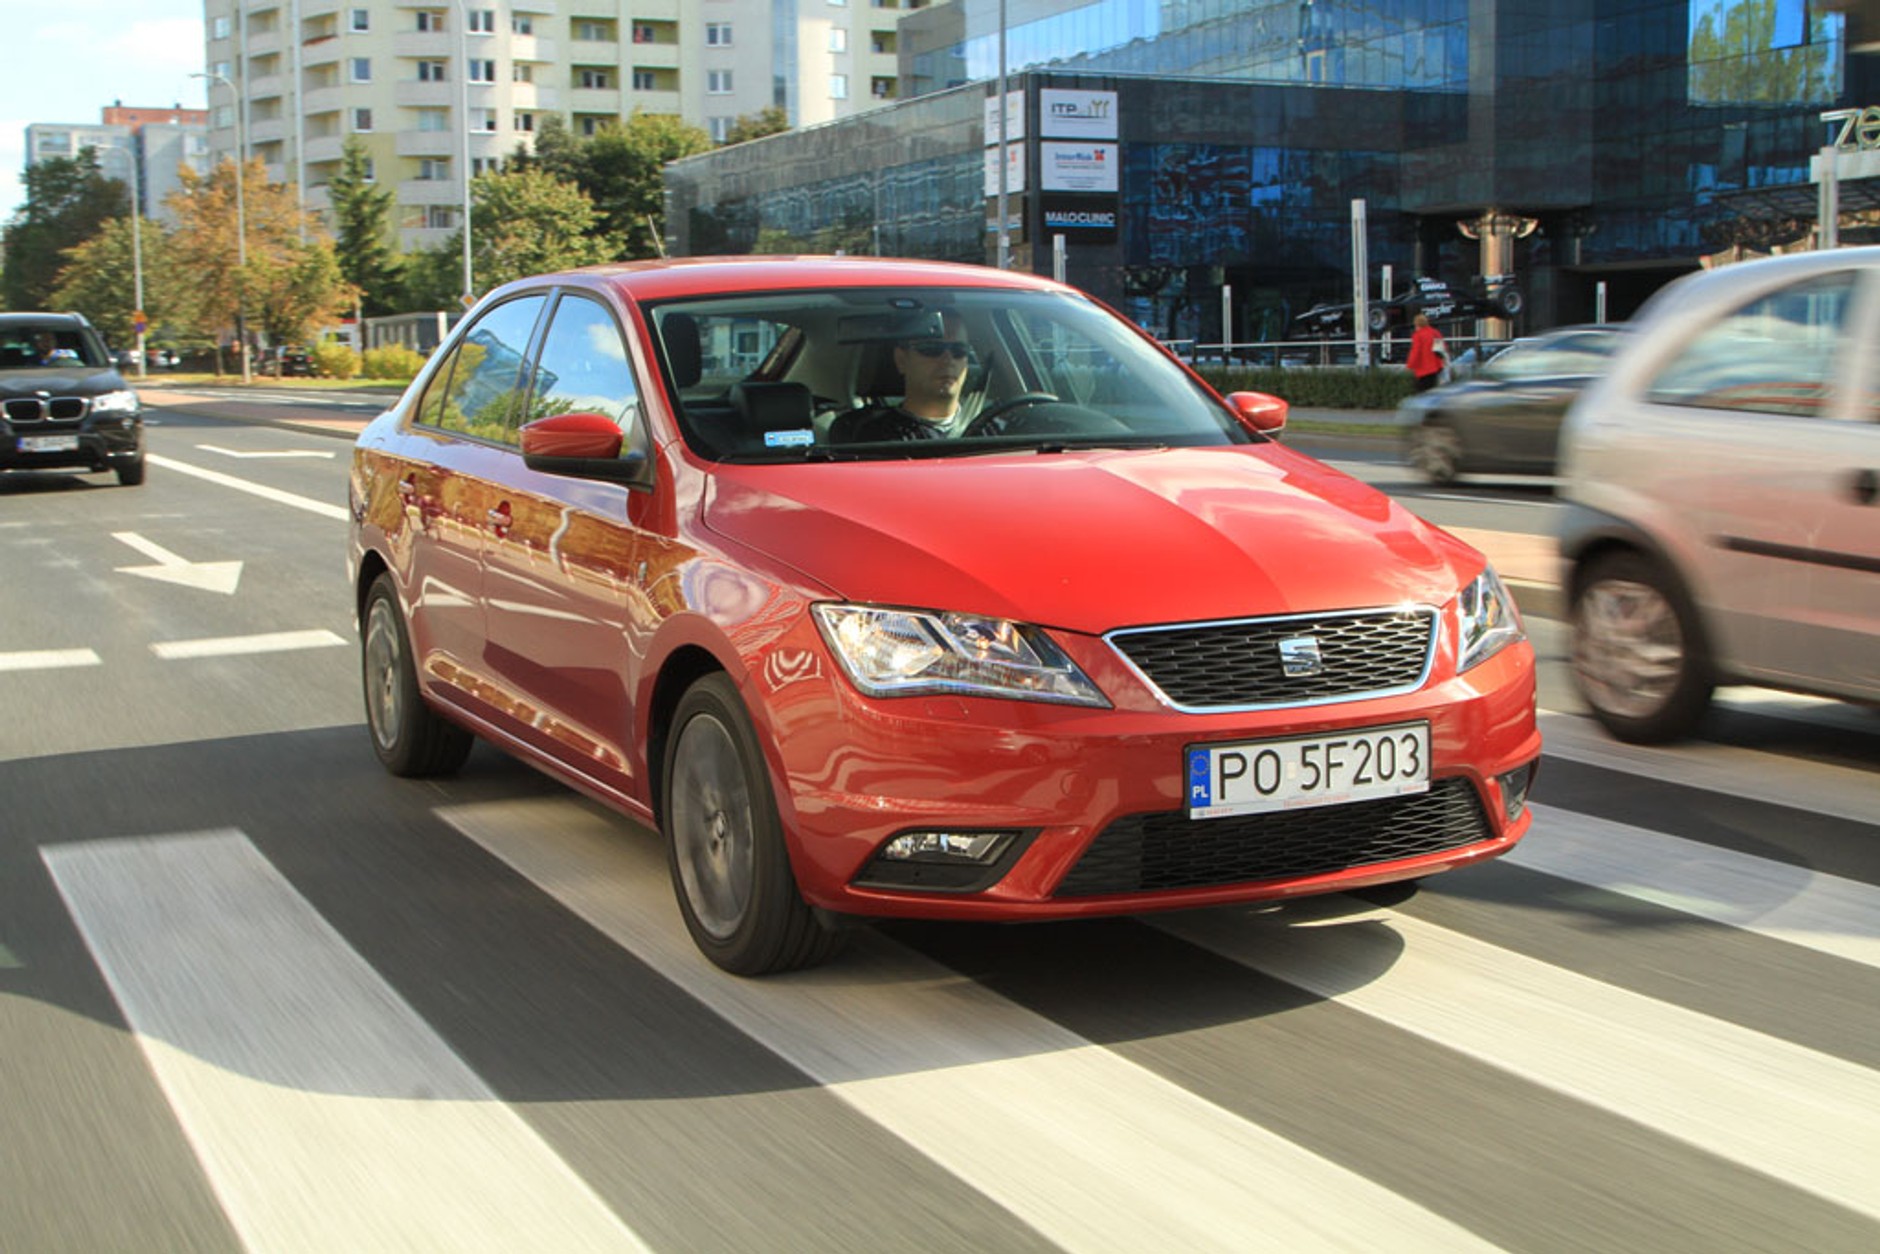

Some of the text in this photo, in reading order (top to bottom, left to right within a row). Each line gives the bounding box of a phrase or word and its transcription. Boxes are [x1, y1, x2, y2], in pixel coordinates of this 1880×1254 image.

[1051, 102, 1078, 113] ITP
[1218, 733, 1420, 800] PO 5F203
[1192, 785, 1209, 799] PL
